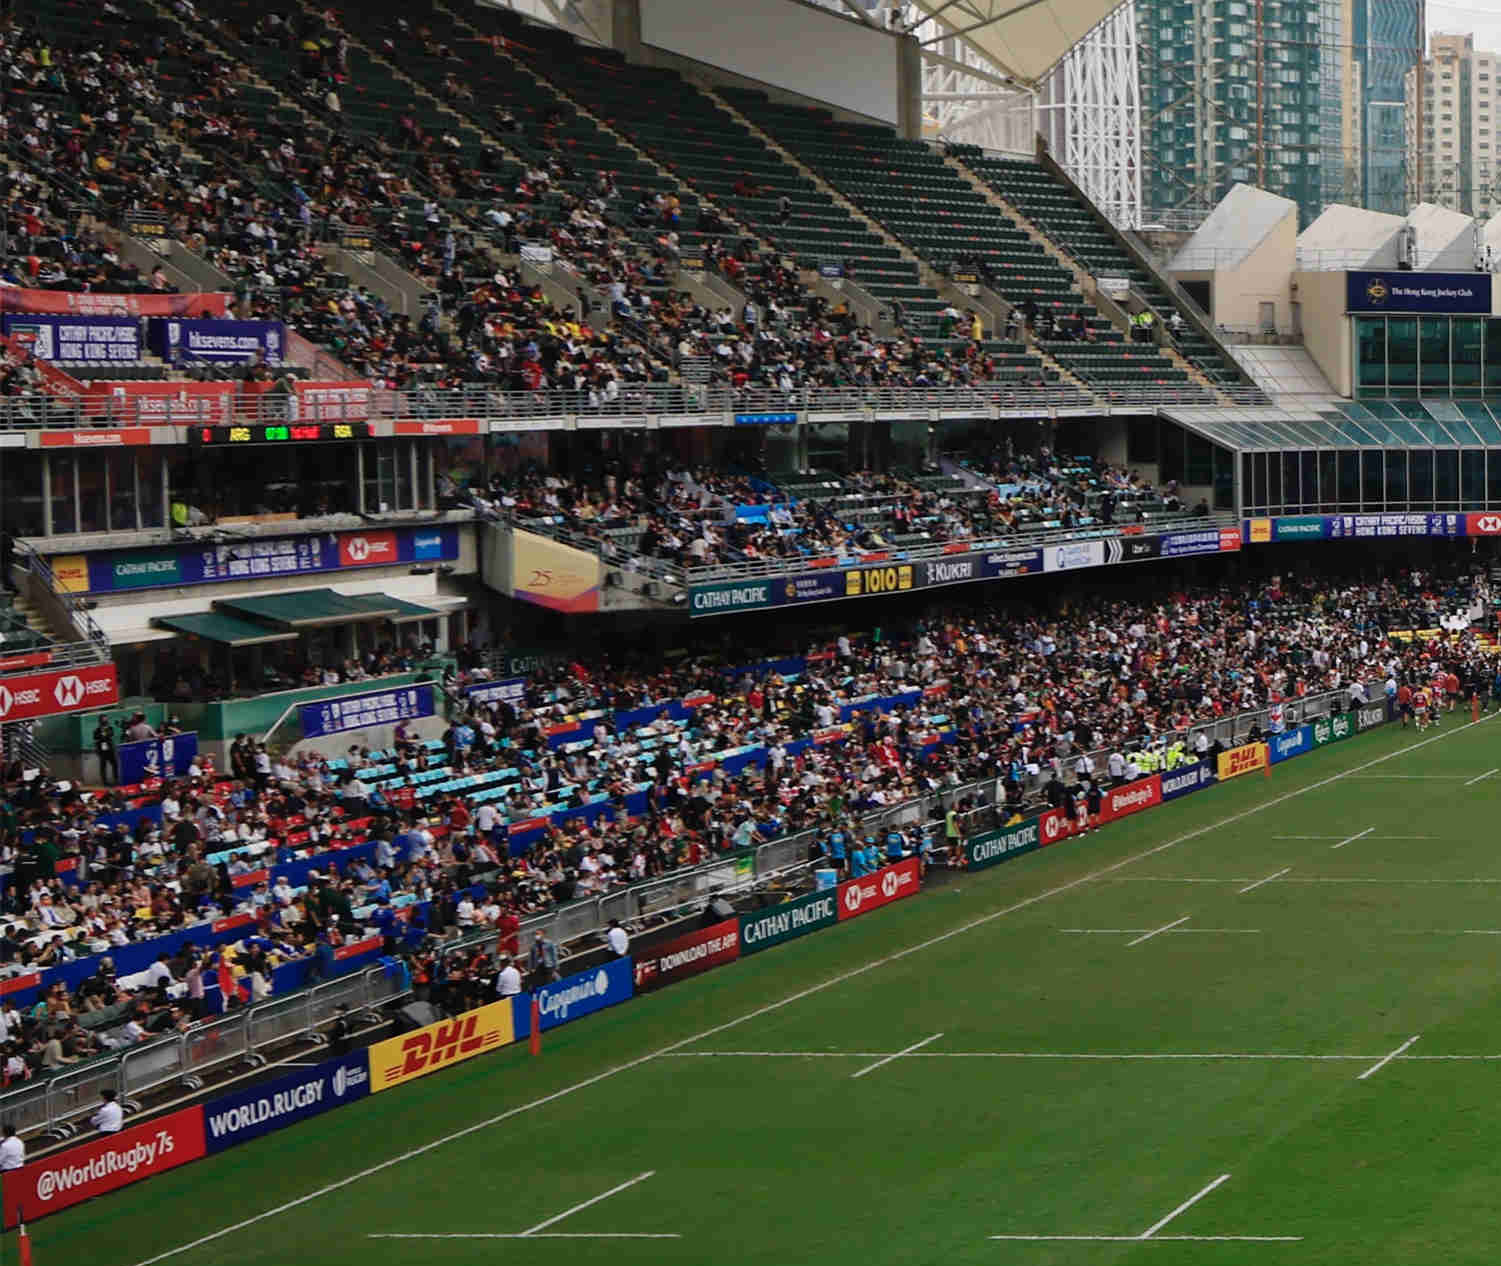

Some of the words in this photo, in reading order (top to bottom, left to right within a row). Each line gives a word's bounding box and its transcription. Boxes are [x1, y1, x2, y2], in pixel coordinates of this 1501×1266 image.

[188, 331, 260, 350] hksevens.com
[864, 568, 897, 593] 1010
[935, 562, 973, 581] KUKRI
[694, 589, 729, 609] CATHAY
[730, 585, 767, 606] PACIFIC
[85, 677, 113, 695] HSBC
[973, 835, 1006, 863] CATHAY
[1006, 825, 1038, 853] PACIFIC
[744, 912, 790, 944] CATHAY
[792, 897, 833, 929] PACIFIC
[660, 943, 705, 972] DOWNLOAD
[707, 940, 721, 959] THE
[538, 975, 595, 1018] Capgemini
[400, 1014, 486, 1076] DHL
[210, 1079, 325, 1139] WORLD.RUGBY
[36, 1131, 175, 1201] @WorldRugby7s
